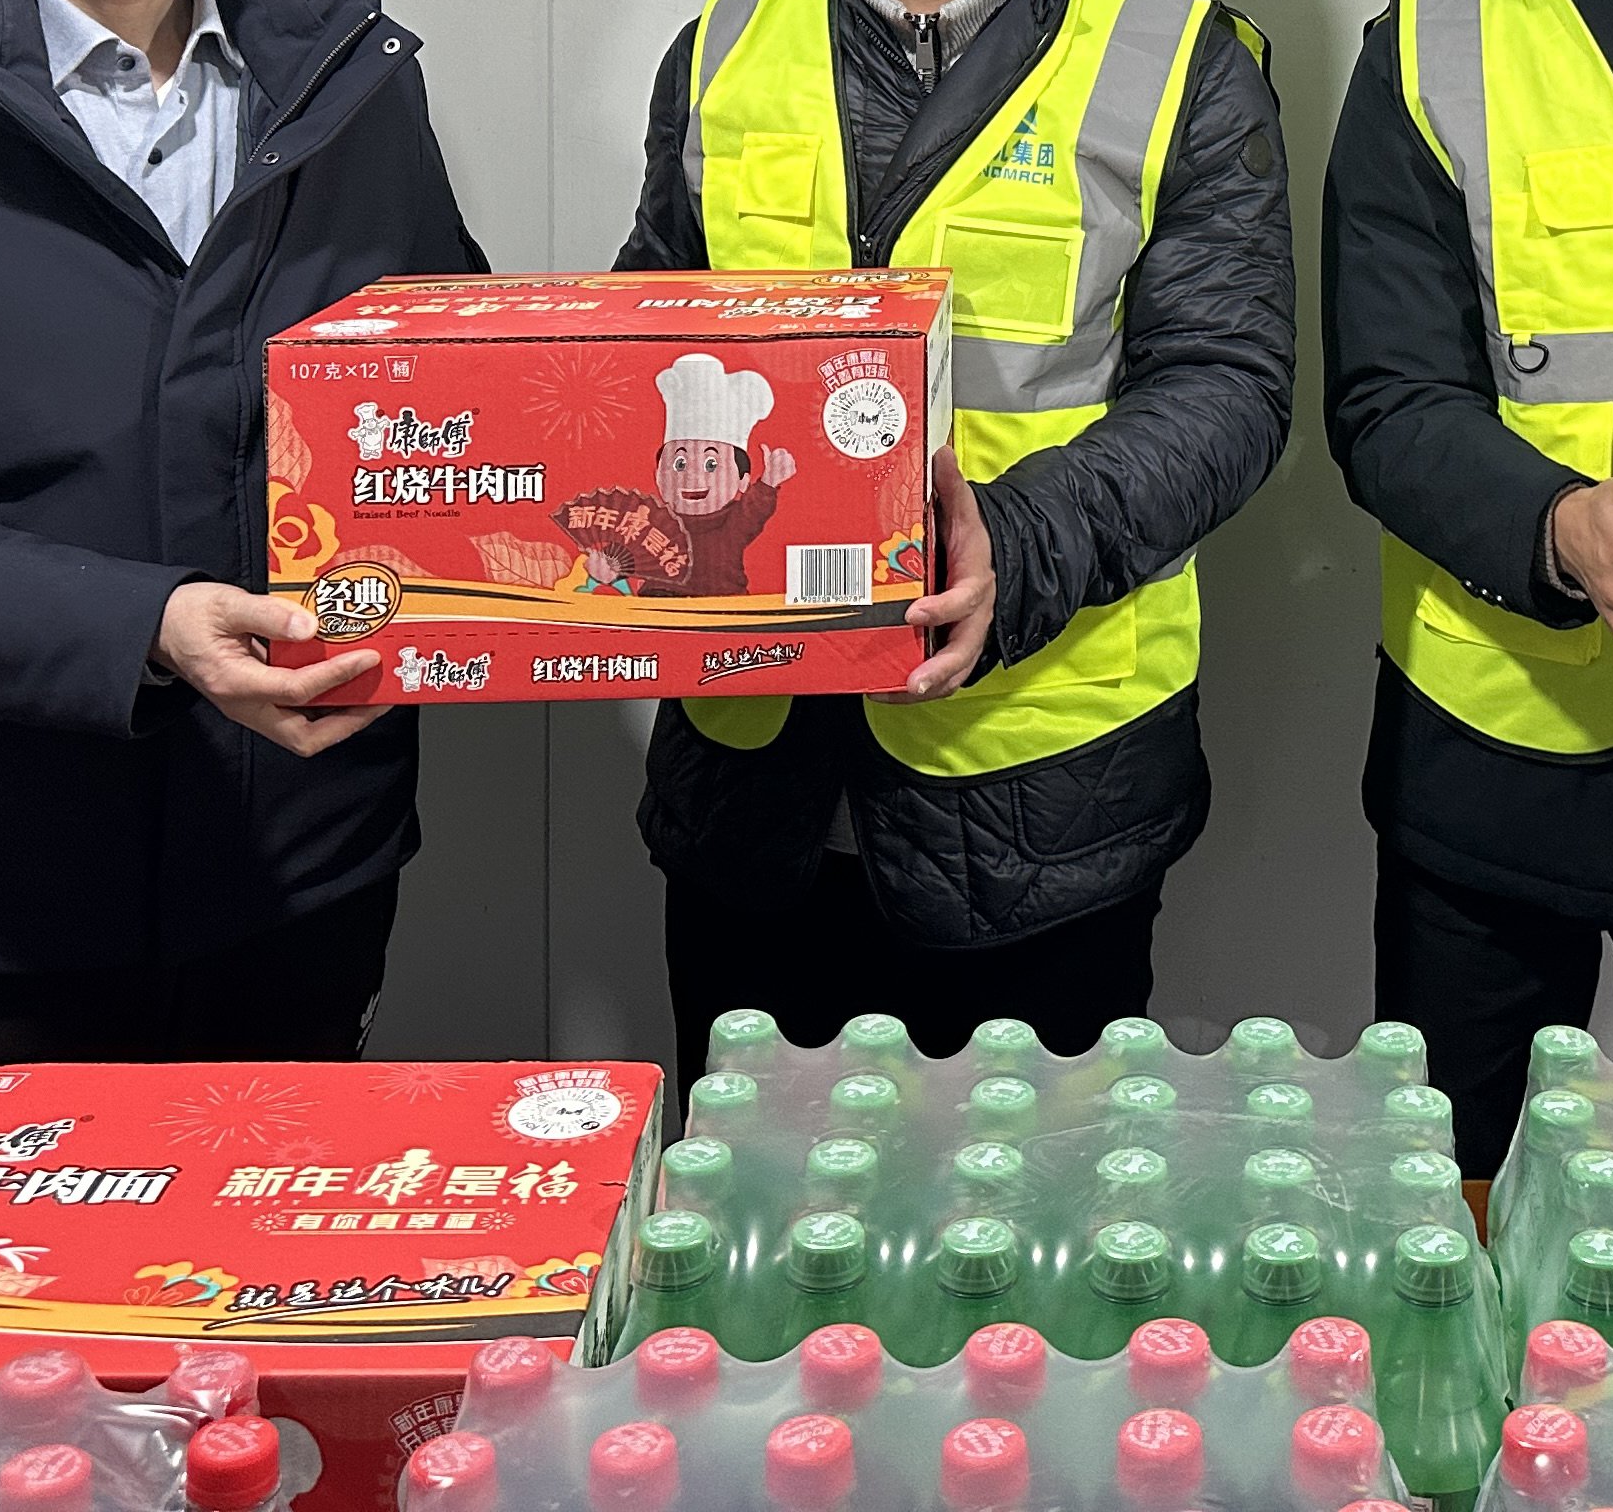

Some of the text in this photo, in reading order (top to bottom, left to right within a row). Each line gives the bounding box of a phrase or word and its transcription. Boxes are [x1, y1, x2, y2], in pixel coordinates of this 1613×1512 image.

[353, 463, 545, 505] 红烧牛肉面
[353, 509, 461, 519] Braised Beef Noodle
[315, 577, 390, 616] 经典
[532, 653, 659, 683] 红烧牛肉面
[217, 1148, 579, 1206] 新年康是福
